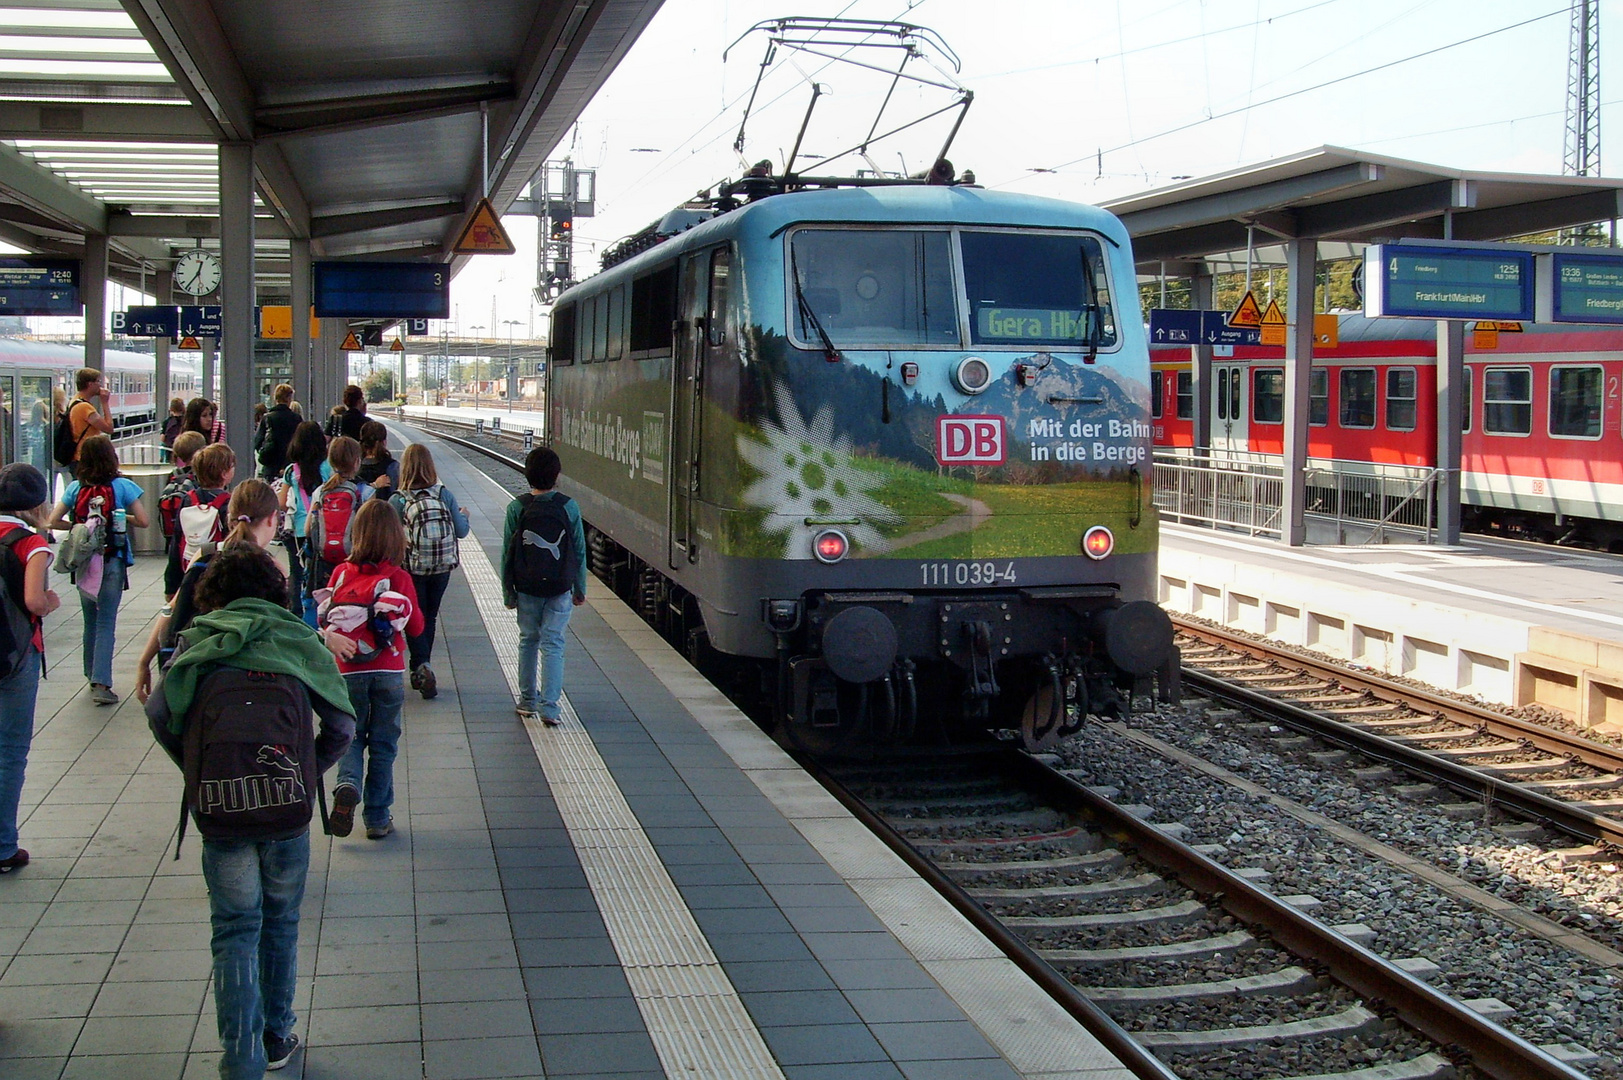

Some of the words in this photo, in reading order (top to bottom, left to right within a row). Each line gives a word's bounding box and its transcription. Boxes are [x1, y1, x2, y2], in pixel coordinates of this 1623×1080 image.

[52, 270, 72, 278] 12:40
[1389, 257, 1399, 274] 4
[433, 272, 442, 286] 3
[113, 312, 126, 329] B
[199, 306, 205, 319] 1
[1221, 312, 1228, 326] 1
[988, 308, 1043, 338] Gera
[1050, 310, 1089, 338] Hbf
[1221, 330, 1241, 338] Ausgang
[1166, 377, 1172, 396] 1
[1608, 376, 1618, 398] 2
[476, 424, 483, 433] H
[1030, 419, 1064, 438] Mit
[1069, 419, 1102, 438] der
[1108, 419, 1150, 438] Bahn
[524, 436, 532, 448] H
[604, 413, 615, 461] die
[616, 415, 640, 480] Berge
[945, 422, 999, 457] DB
[1030, 442, 1049, 461] in
[1056, 442, 1086, 461] die
[1092, 442, 1146, 465] Berge
[1532, 480, 1544, 493] DB
[920, 563, 950, 586] 111
[955, 561, 1017, 584] 039-4
[200, 774, 303, 815] PUMA
